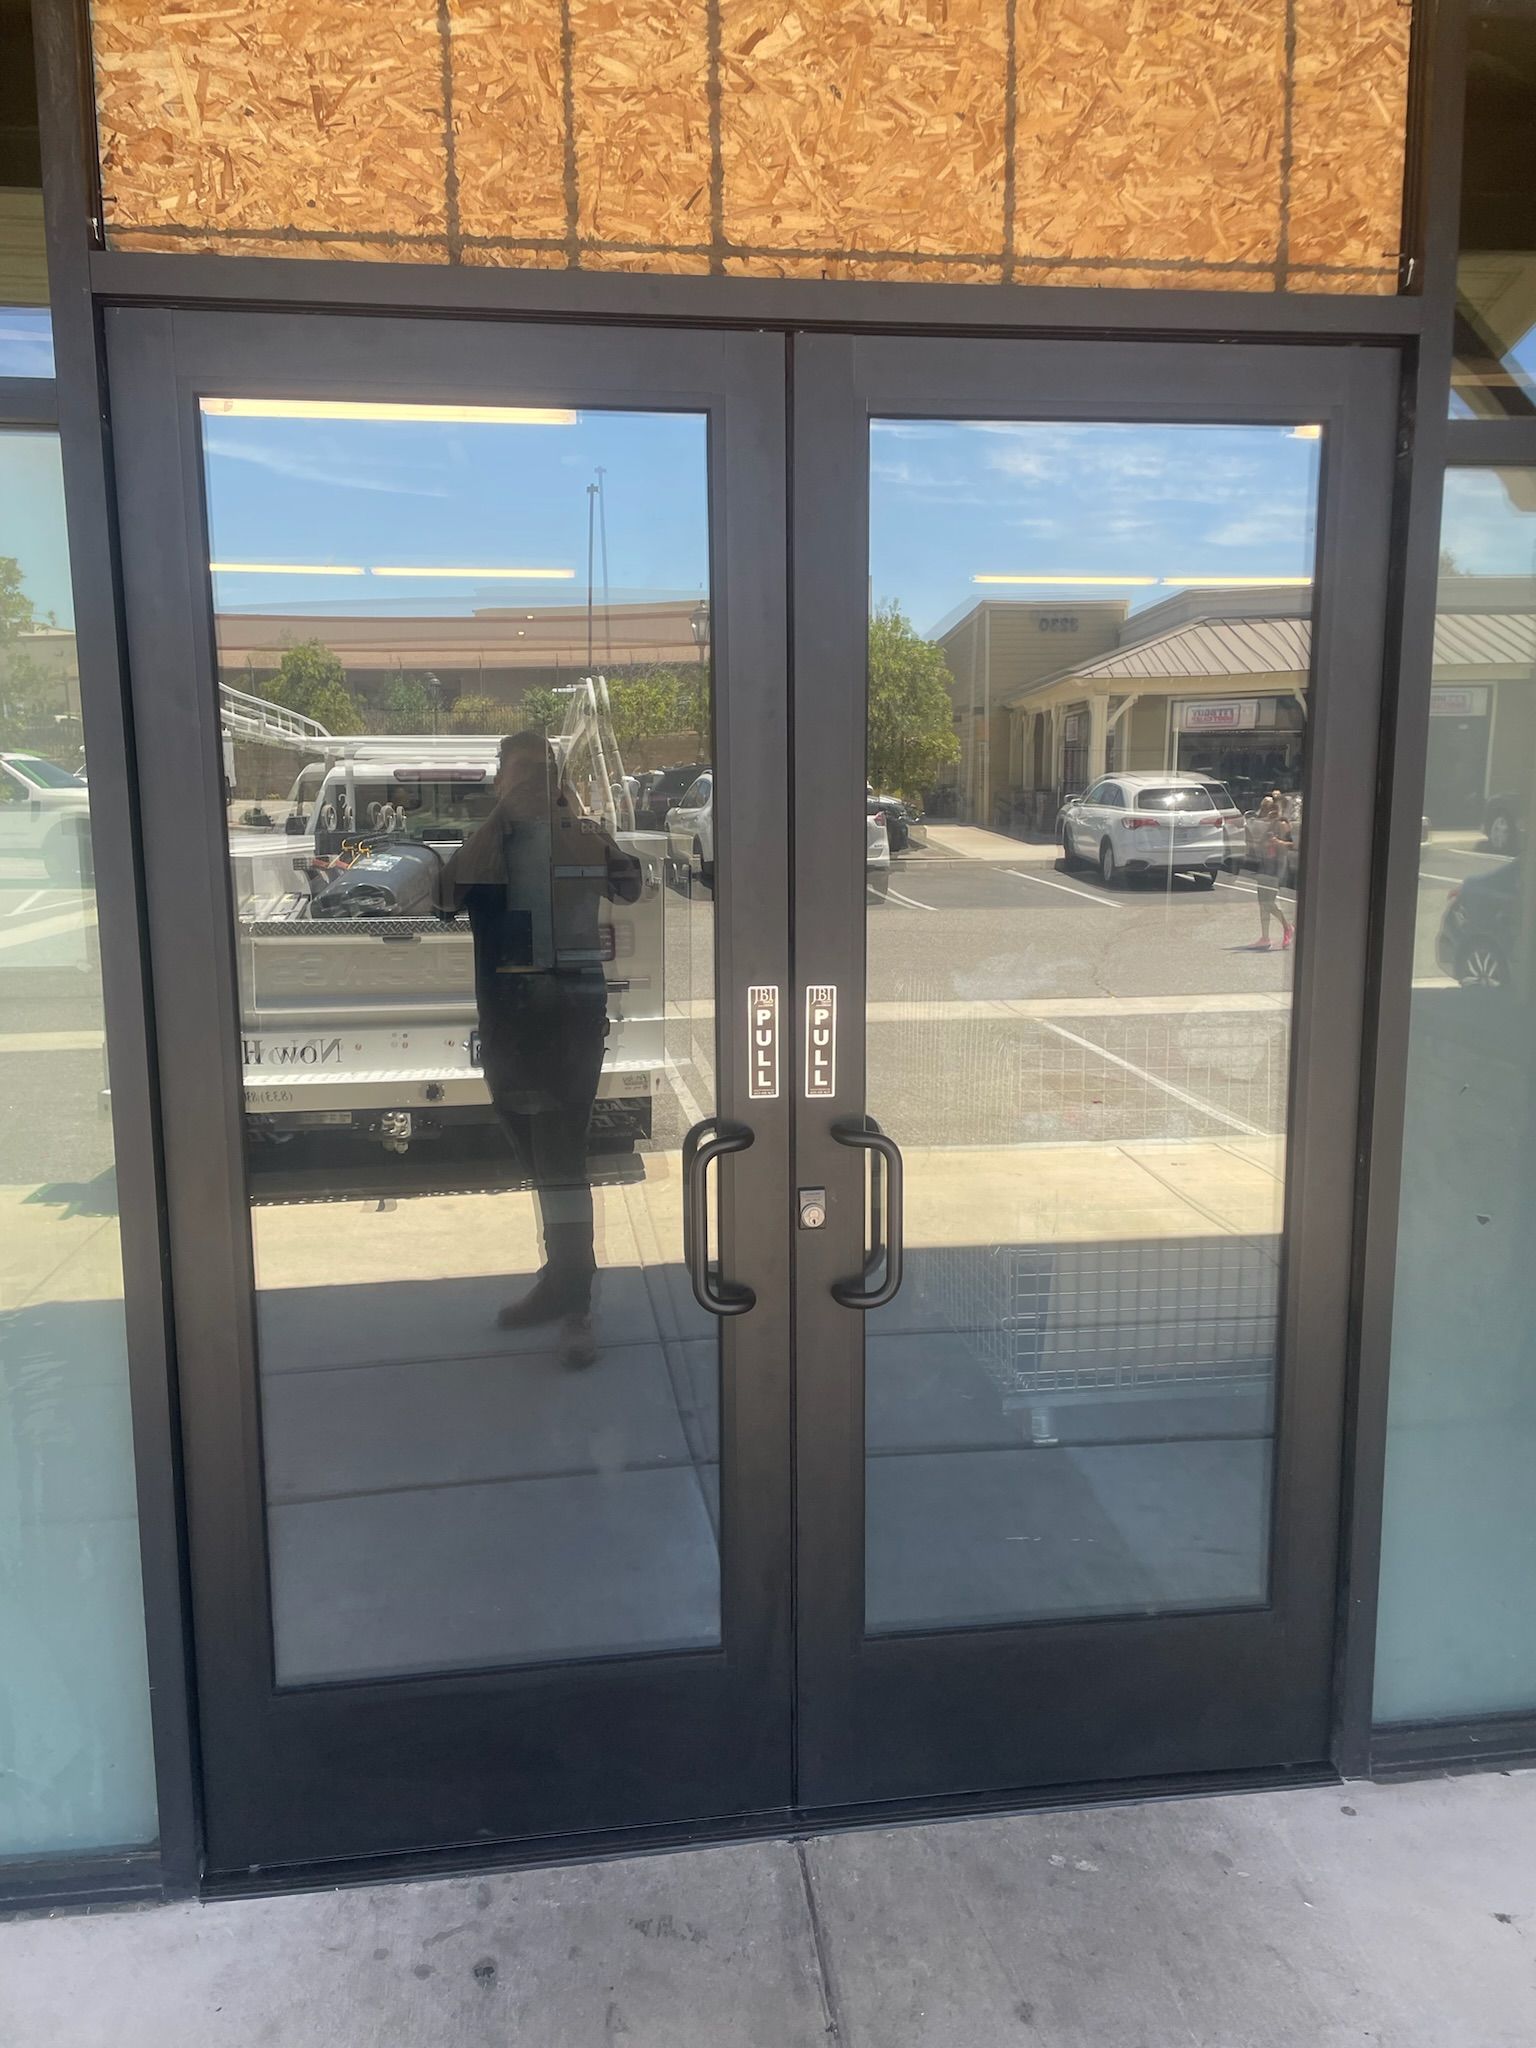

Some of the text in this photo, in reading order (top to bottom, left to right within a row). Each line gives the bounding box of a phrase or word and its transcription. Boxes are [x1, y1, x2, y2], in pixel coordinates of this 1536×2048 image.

[753, 988, 774, 1005] JBI
[811, 988, 832, 1005] JBI
[756, 1009, 772, 1087] PULL
[813, 1008, 830, 1086] PULL
